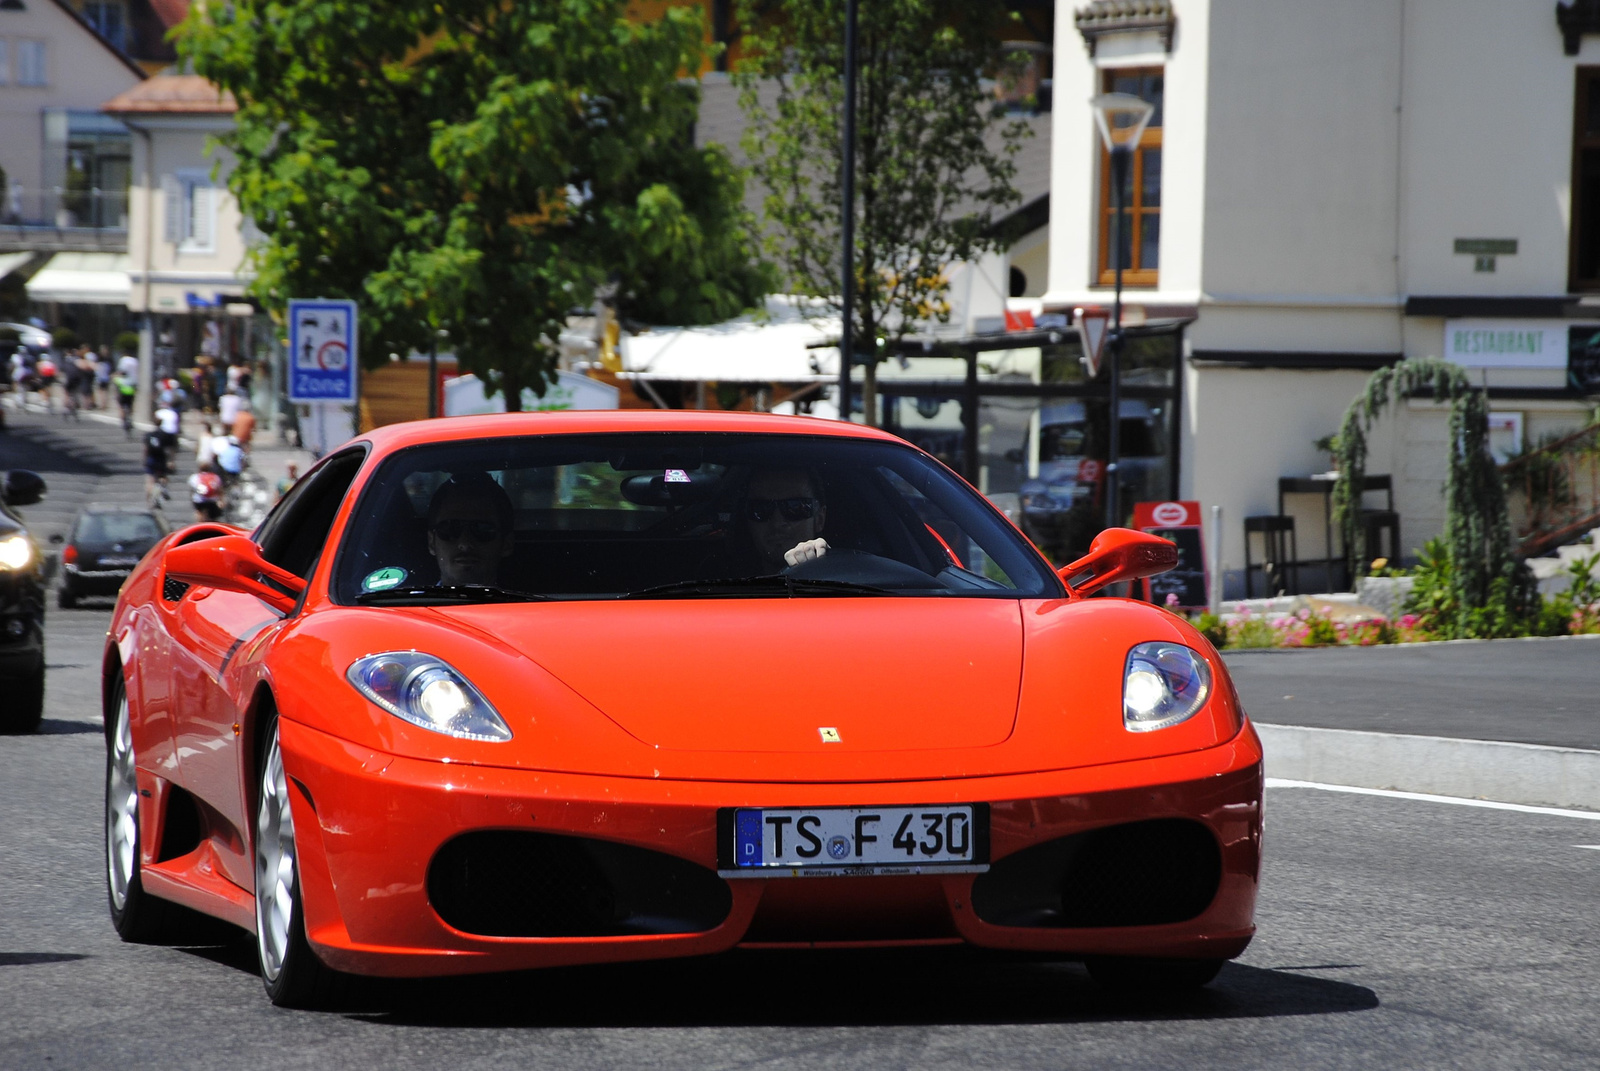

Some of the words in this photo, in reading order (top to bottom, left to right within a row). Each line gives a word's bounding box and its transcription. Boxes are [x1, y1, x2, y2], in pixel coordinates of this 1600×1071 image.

[1454, 330, 1544, 353] RESTAURANT
[297, 374, 346, 393] Zone
[379, 570, 390, 579] 4
[765, 815, 822, 859] TS
[855, 815, 881, 857] F
[893, 812, 969, 856] 430
[745, 842, 755, 856] D
